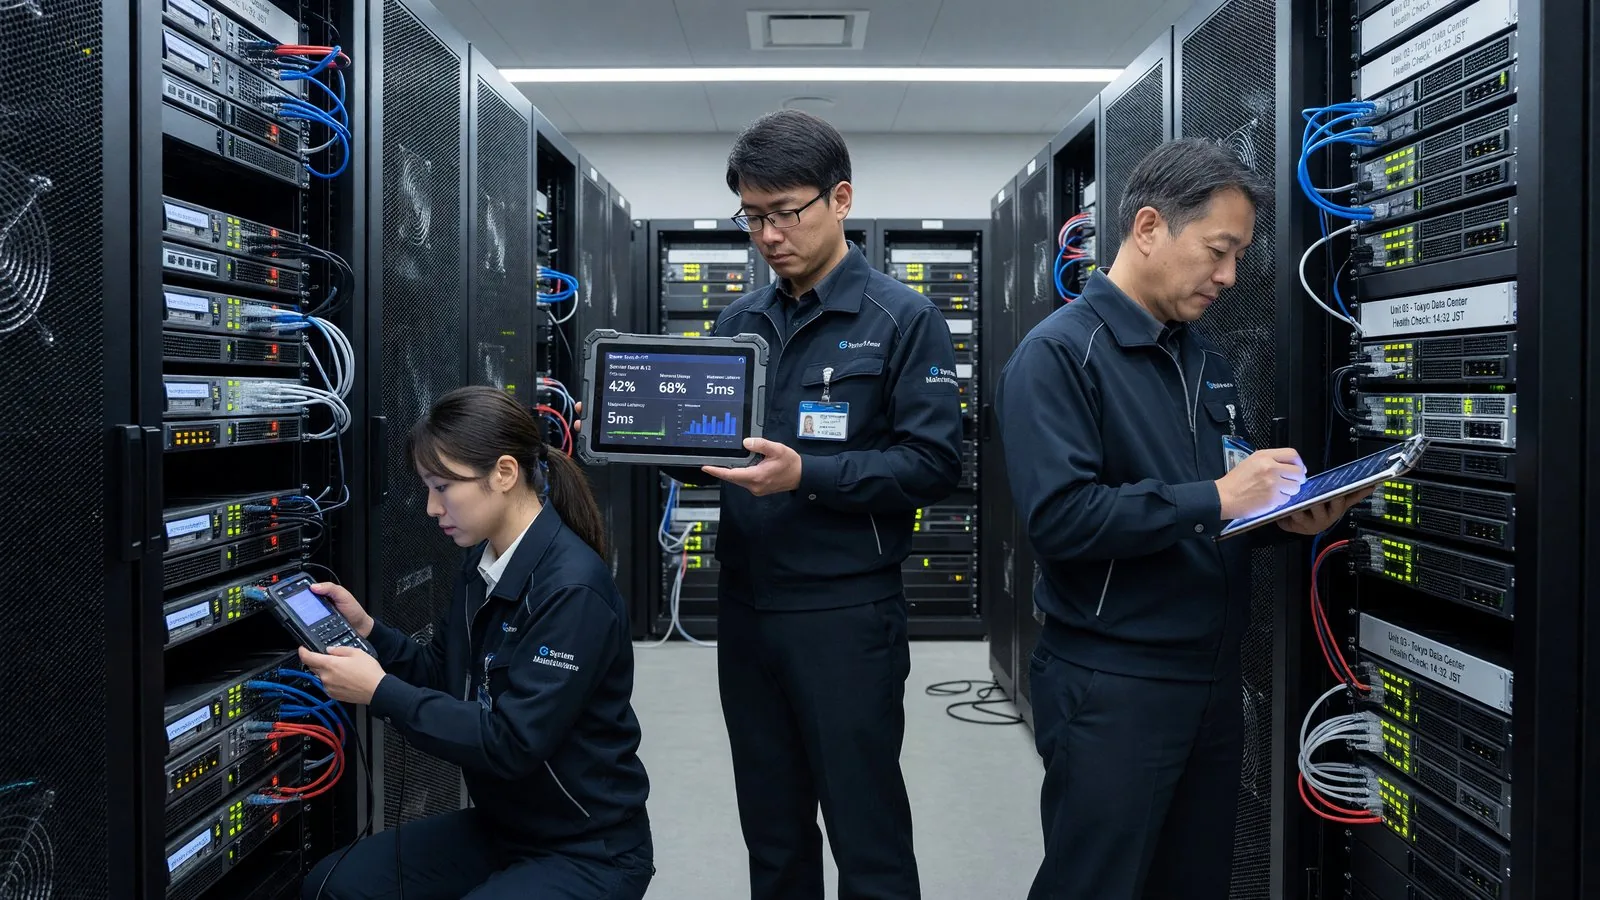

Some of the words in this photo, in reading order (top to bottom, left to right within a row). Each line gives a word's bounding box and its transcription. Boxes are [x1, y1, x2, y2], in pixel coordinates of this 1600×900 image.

[1414, 38, 1431, 53] Tokyo
[1432, 28, 1446, 43] Data
[1447, 16, 1469, 34] Center
[1434, 38, 1452, 55] 14:32
[1453, 30, 1466, 46] JST
[1390, 304, 1401, 314] Unit
[1414, 302, 1430, 312] Tokyo
[1432, 300, 1445, 310] Data
[1446, 297, 1468, 307] Center
[1393, 317, 1410, 328] Health
[1411, 315, 1431, 325] Check:
[1433, 312, 1450, 324] 14:32
[1452, 310, 1464, 322] JST
[609, 380, 636, 392] 42%
[659, 382, 686, 393] 68%
[706, 383, 734, 395] 5ms
[607, 412, 634, 424] 5ms
[1388, 632, 1399, 644] Unit
[1412, 641, 1428, 656] Tokyo
[1429, 648, 1442, 662] Data
[1444, 654, 1465, 670] Center
[1390, 645, 1407, 660] Health
[1408, 653, 1428, 670] Check:
[1430, 663, 1447, 678] 14:32
[1449, 671, 1461, 684] JST
